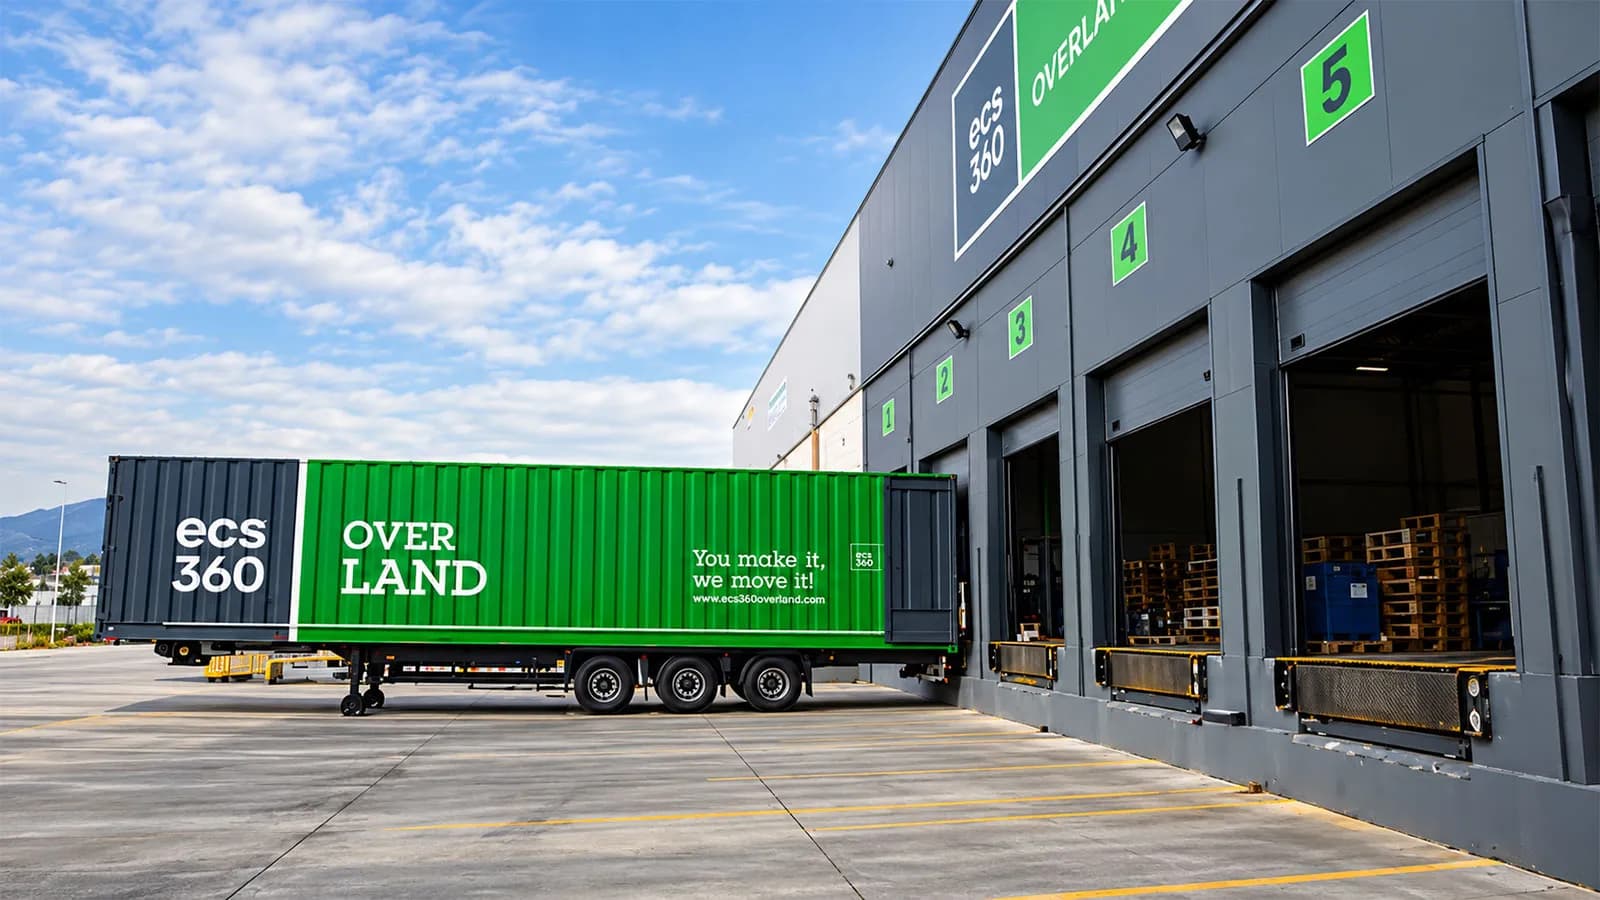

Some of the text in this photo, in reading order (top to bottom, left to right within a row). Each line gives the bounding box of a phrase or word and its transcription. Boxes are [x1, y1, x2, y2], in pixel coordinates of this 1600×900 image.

[1322, 44, 1352, 114] 5
[968, 85, 1003, 150] ecs
[969, 125, 1005, 194] 360
[1120, 221, 1138, 263] 4
[1015, 310, 1026, 345] 3
[940, 366, 950, 394] 2
[885, 406, 893, 430] 1
[176, 517, 267, 549] ecs
[343, 520, 456, 552] OVER
[171, 555, 265, 594] 360
[692, 549, 826, 571] You make it,
[855, 558, 874, 568] 360
[340, 558, 488, 597] LAND
[692, 571, 814, 590] we move it!
[692, 593, 826, 605] www.ecs360overland.com
